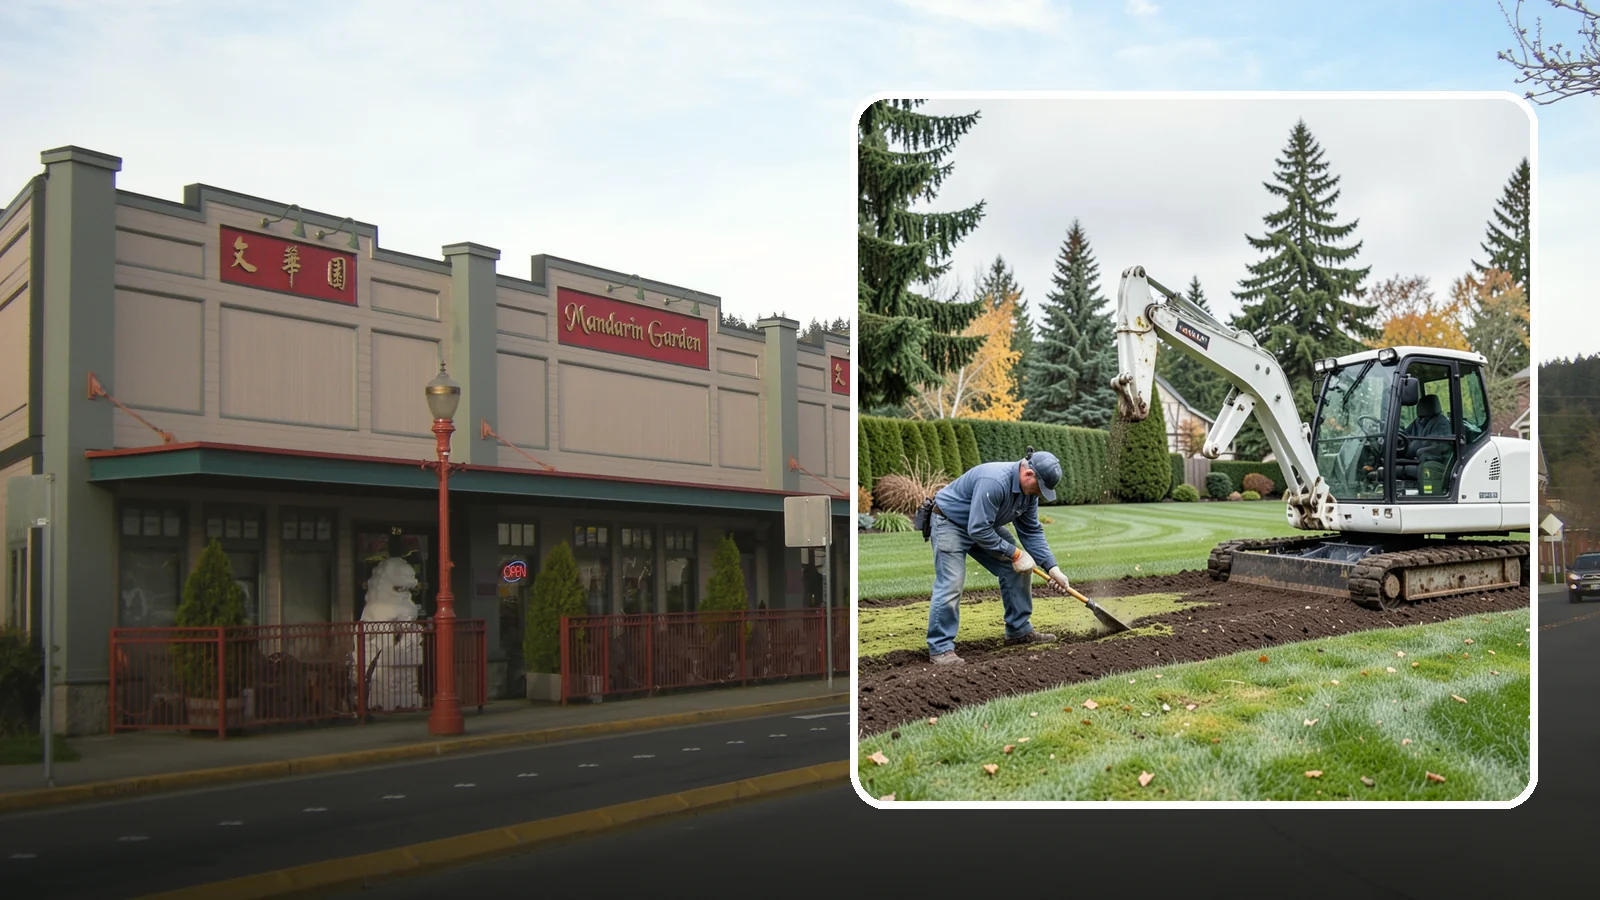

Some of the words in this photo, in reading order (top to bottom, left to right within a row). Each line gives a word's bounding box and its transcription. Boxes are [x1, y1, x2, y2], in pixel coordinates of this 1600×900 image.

[564, 302, 644, 341] Mandarin
[648, 320, 701, 352] Garden
[503, 565, 527, 577] OPEN
